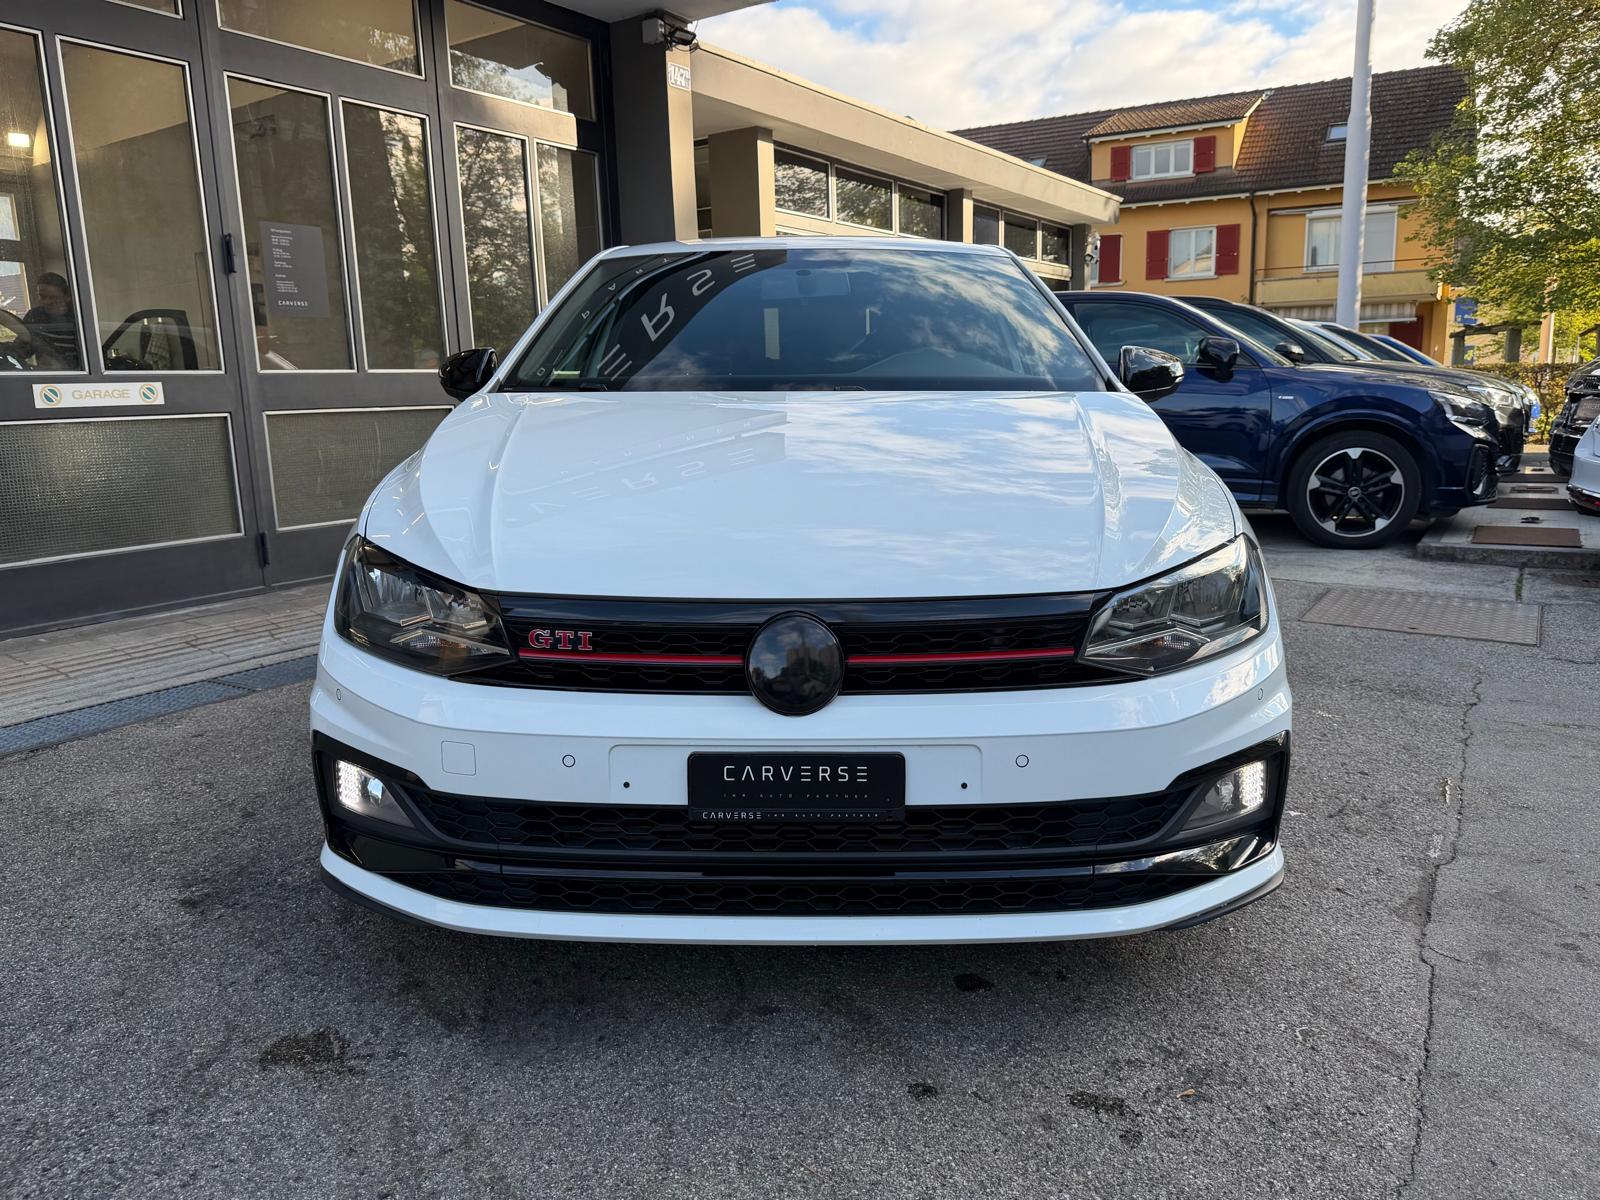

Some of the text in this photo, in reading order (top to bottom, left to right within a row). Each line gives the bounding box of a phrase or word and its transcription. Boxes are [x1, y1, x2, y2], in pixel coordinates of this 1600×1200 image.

[72, 389, 131, 400] GARAGE
[528, 628, 593, 651] GTI
[723, 765, 868, 782] CARVERSE
[702, 811, 762, 820] CARVERSE
